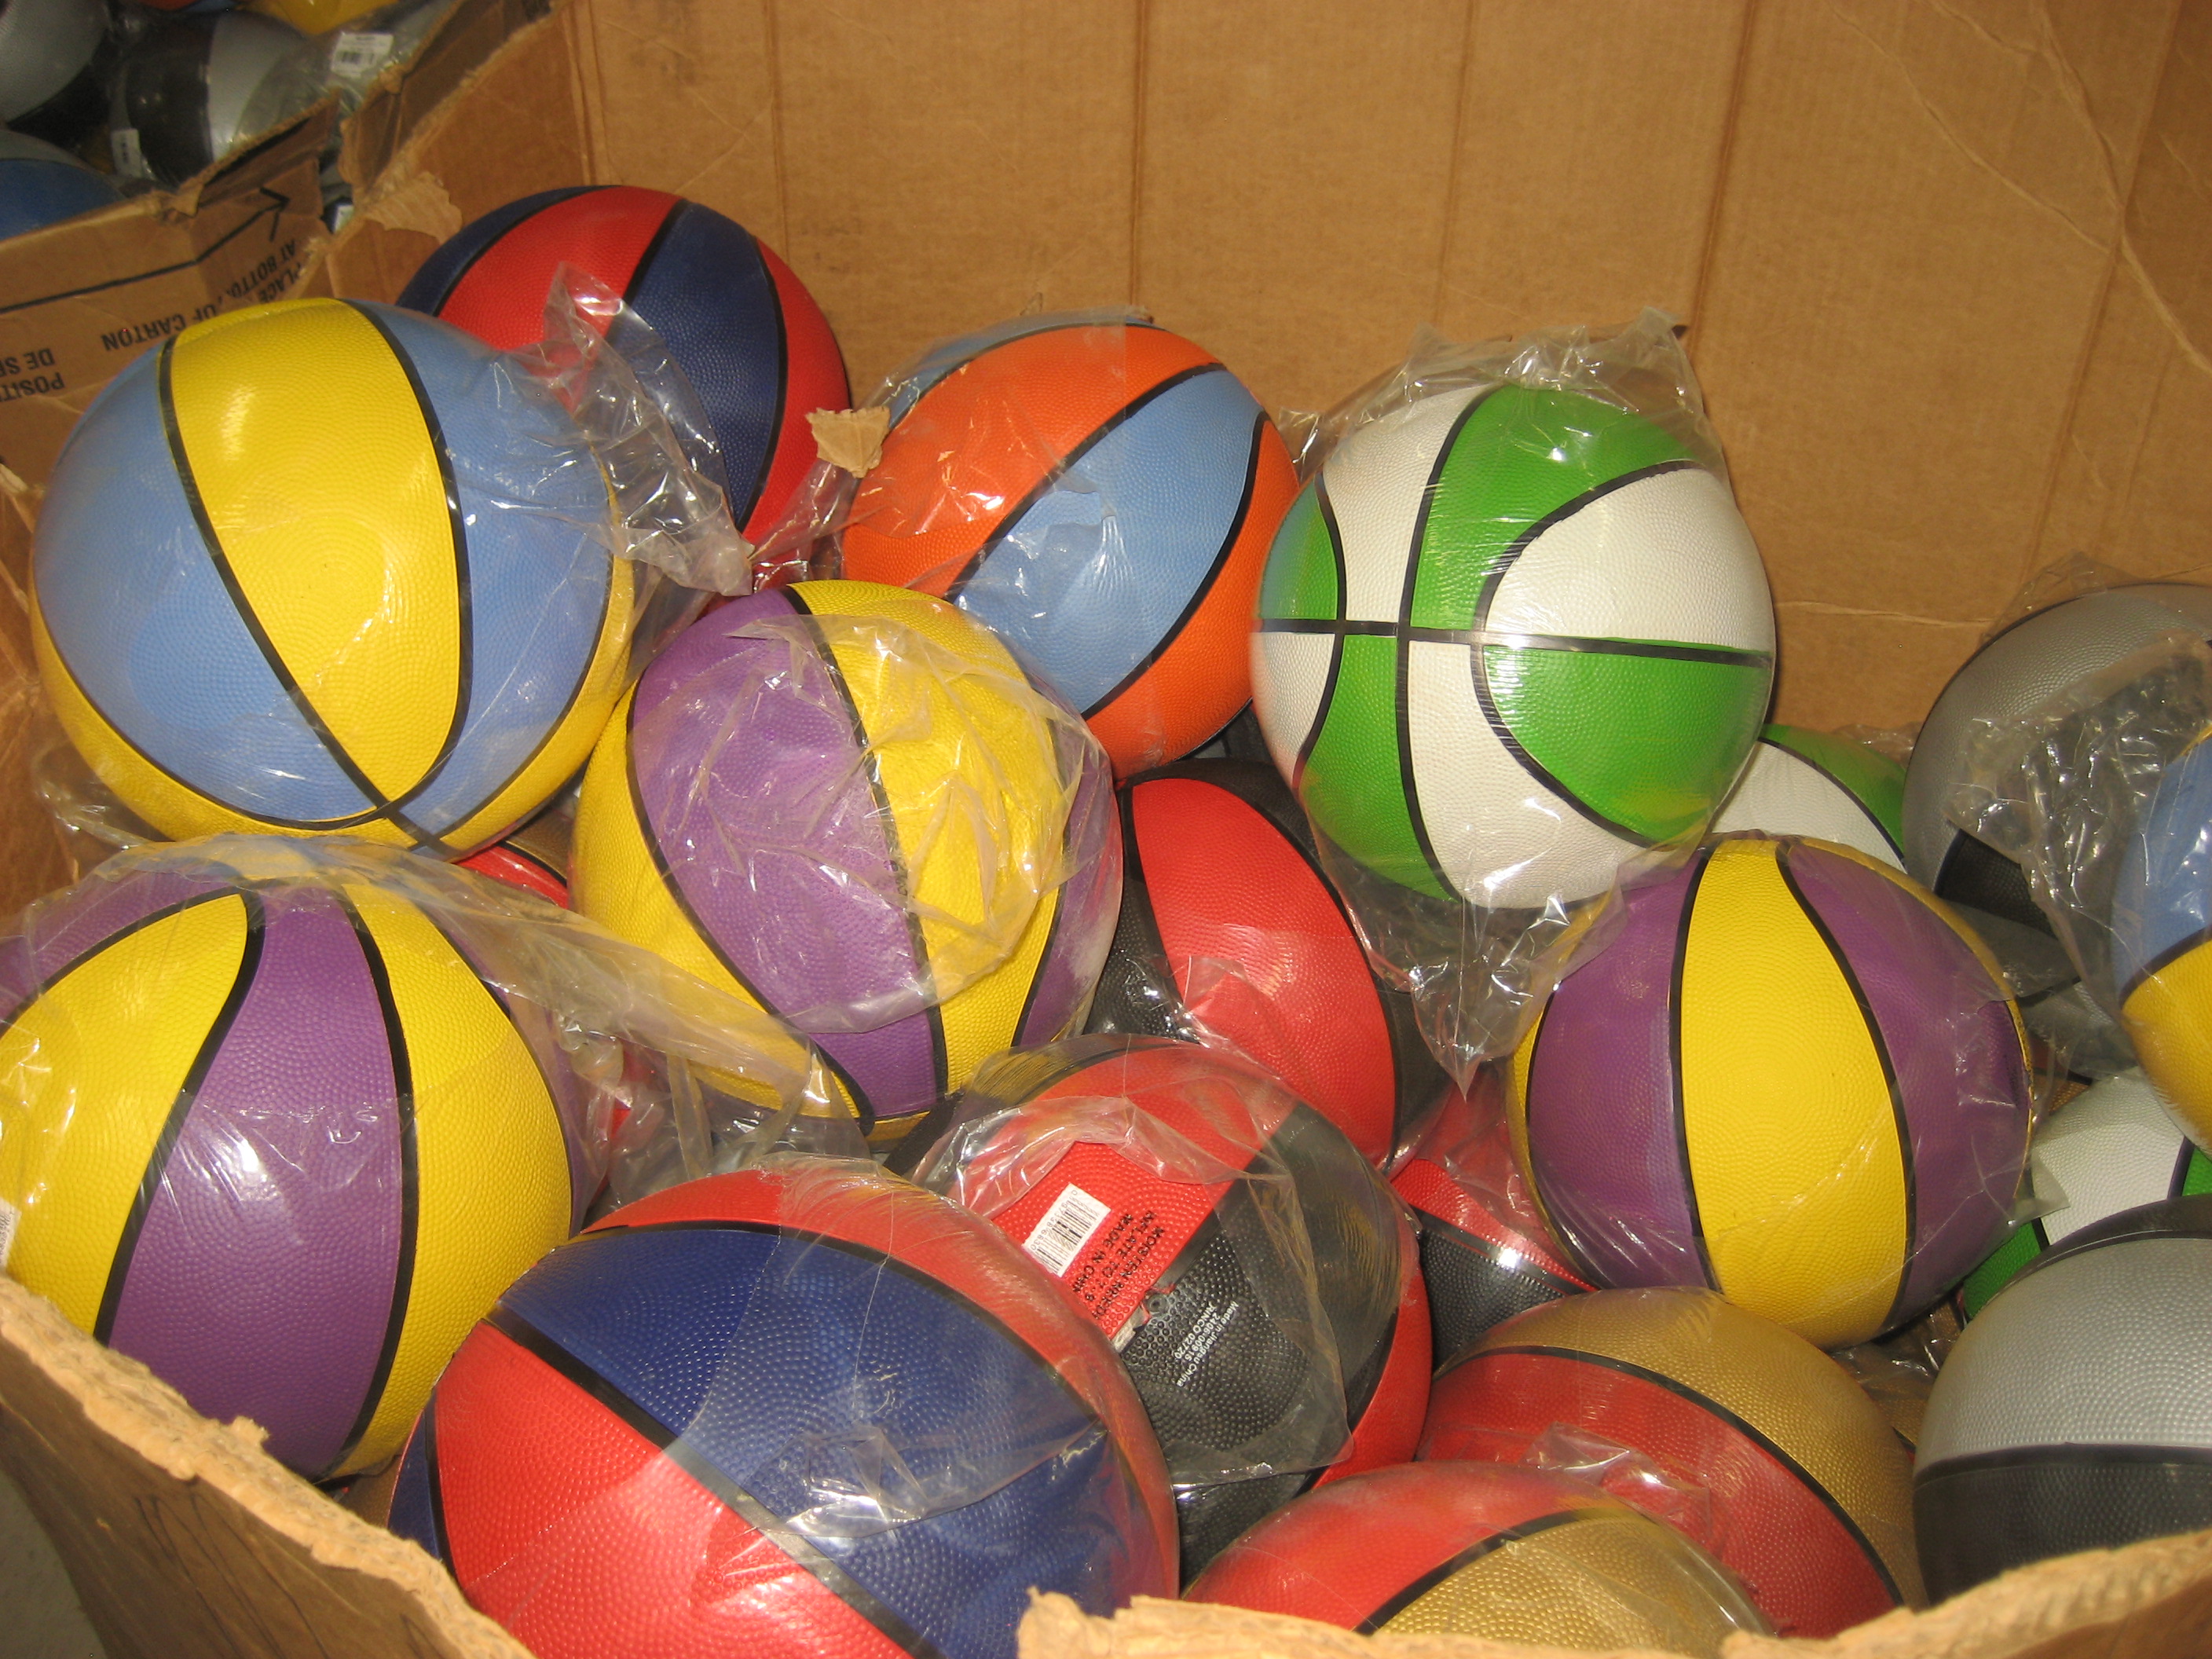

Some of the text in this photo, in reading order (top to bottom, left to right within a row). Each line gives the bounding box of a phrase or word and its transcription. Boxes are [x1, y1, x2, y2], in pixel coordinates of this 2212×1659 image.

[280, 239, 296, 262] AT
[218, 255, 277, 305] BOTTO
[101, 313, 187, 351] CARTON
[23, 348, 55, 370] DE
[0, 372, 65, 402] POSIT
[1073, 1213, 1133, 1292] MADE IN CHIN
[1115, 1210, 1157, 1258] INFLATE
[1092, 1226, 1164, 1320] MOISTEN NEED
[1102, 1261, 1121, 1278] TO
[1174, 1301, 1217, 1359] RINCO 02720
[1177, 1300, 1240, 1387] Made in Jiangsu China
